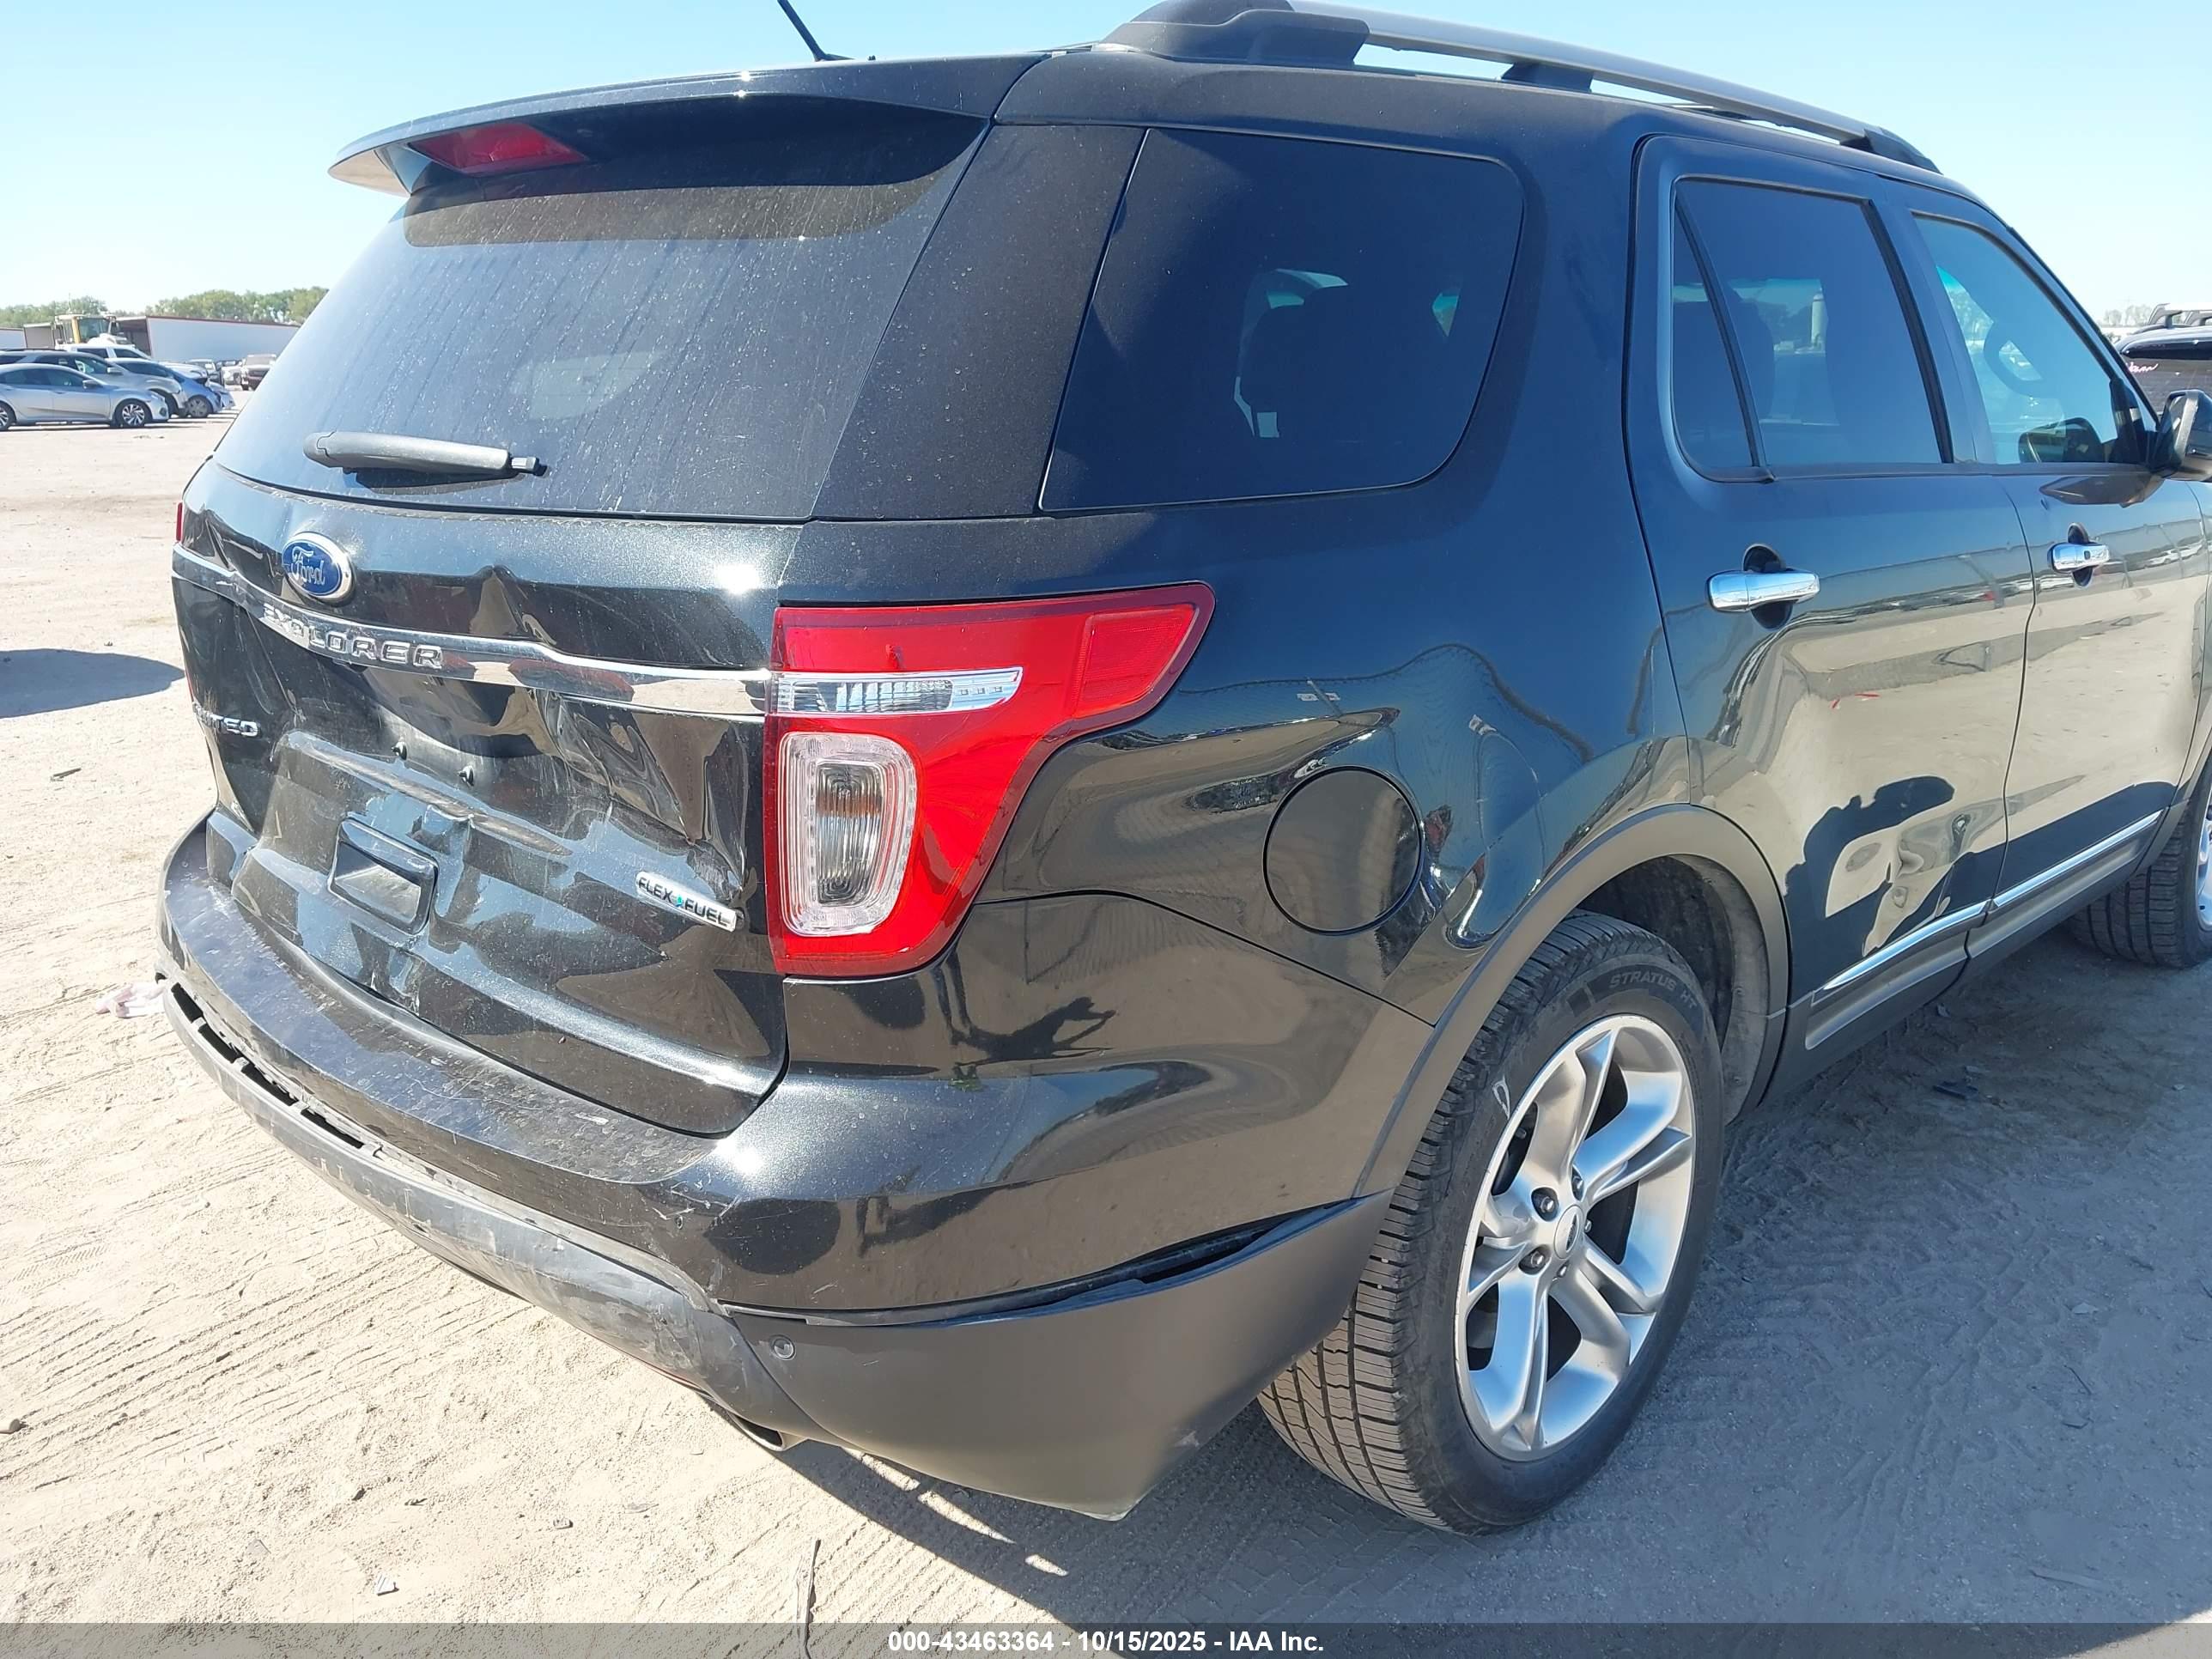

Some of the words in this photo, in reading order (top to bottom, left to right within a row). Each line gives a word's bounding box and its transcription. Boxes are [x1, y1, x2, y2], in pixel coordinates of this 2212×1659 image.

[287, 545, 327, 586] Ford
[263, 603, 444, 669] EXPLORER
[637, 877, 673, 903] FLEX
[684, 897, 728, 927] FUEL
[1609, 970, 1677, 991] STRATUS
